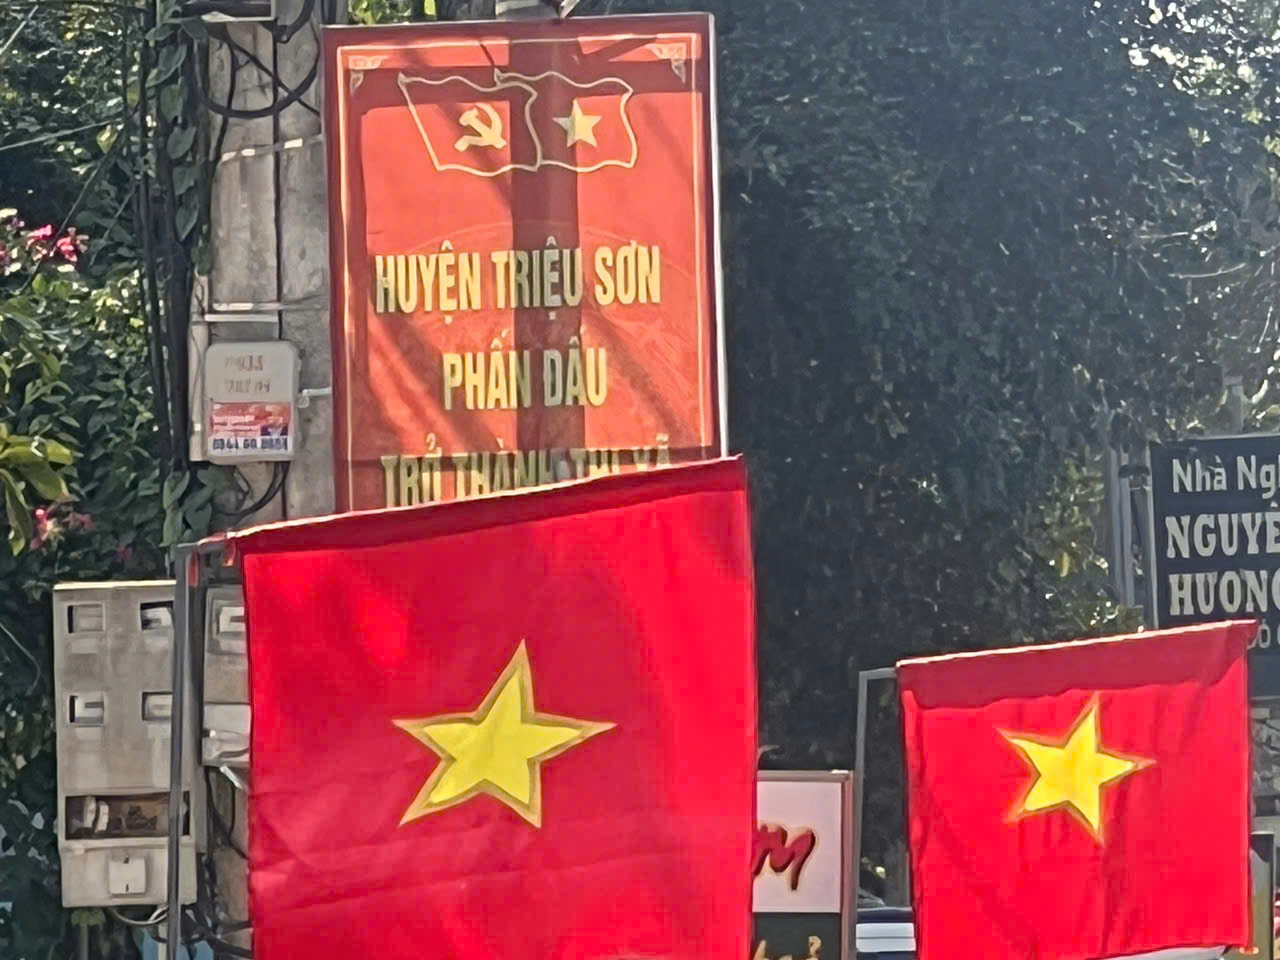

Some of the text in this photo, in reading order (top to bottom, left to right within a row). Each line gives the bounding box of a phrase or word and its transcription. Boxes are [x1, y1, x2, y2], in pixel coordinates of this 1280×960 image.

[376, 236, 661, 324] HUYỆN TRIỆU SƠN
[443, 327, 531, 410] PHẤN
[1172, 455, 1227, 493] Nhà
